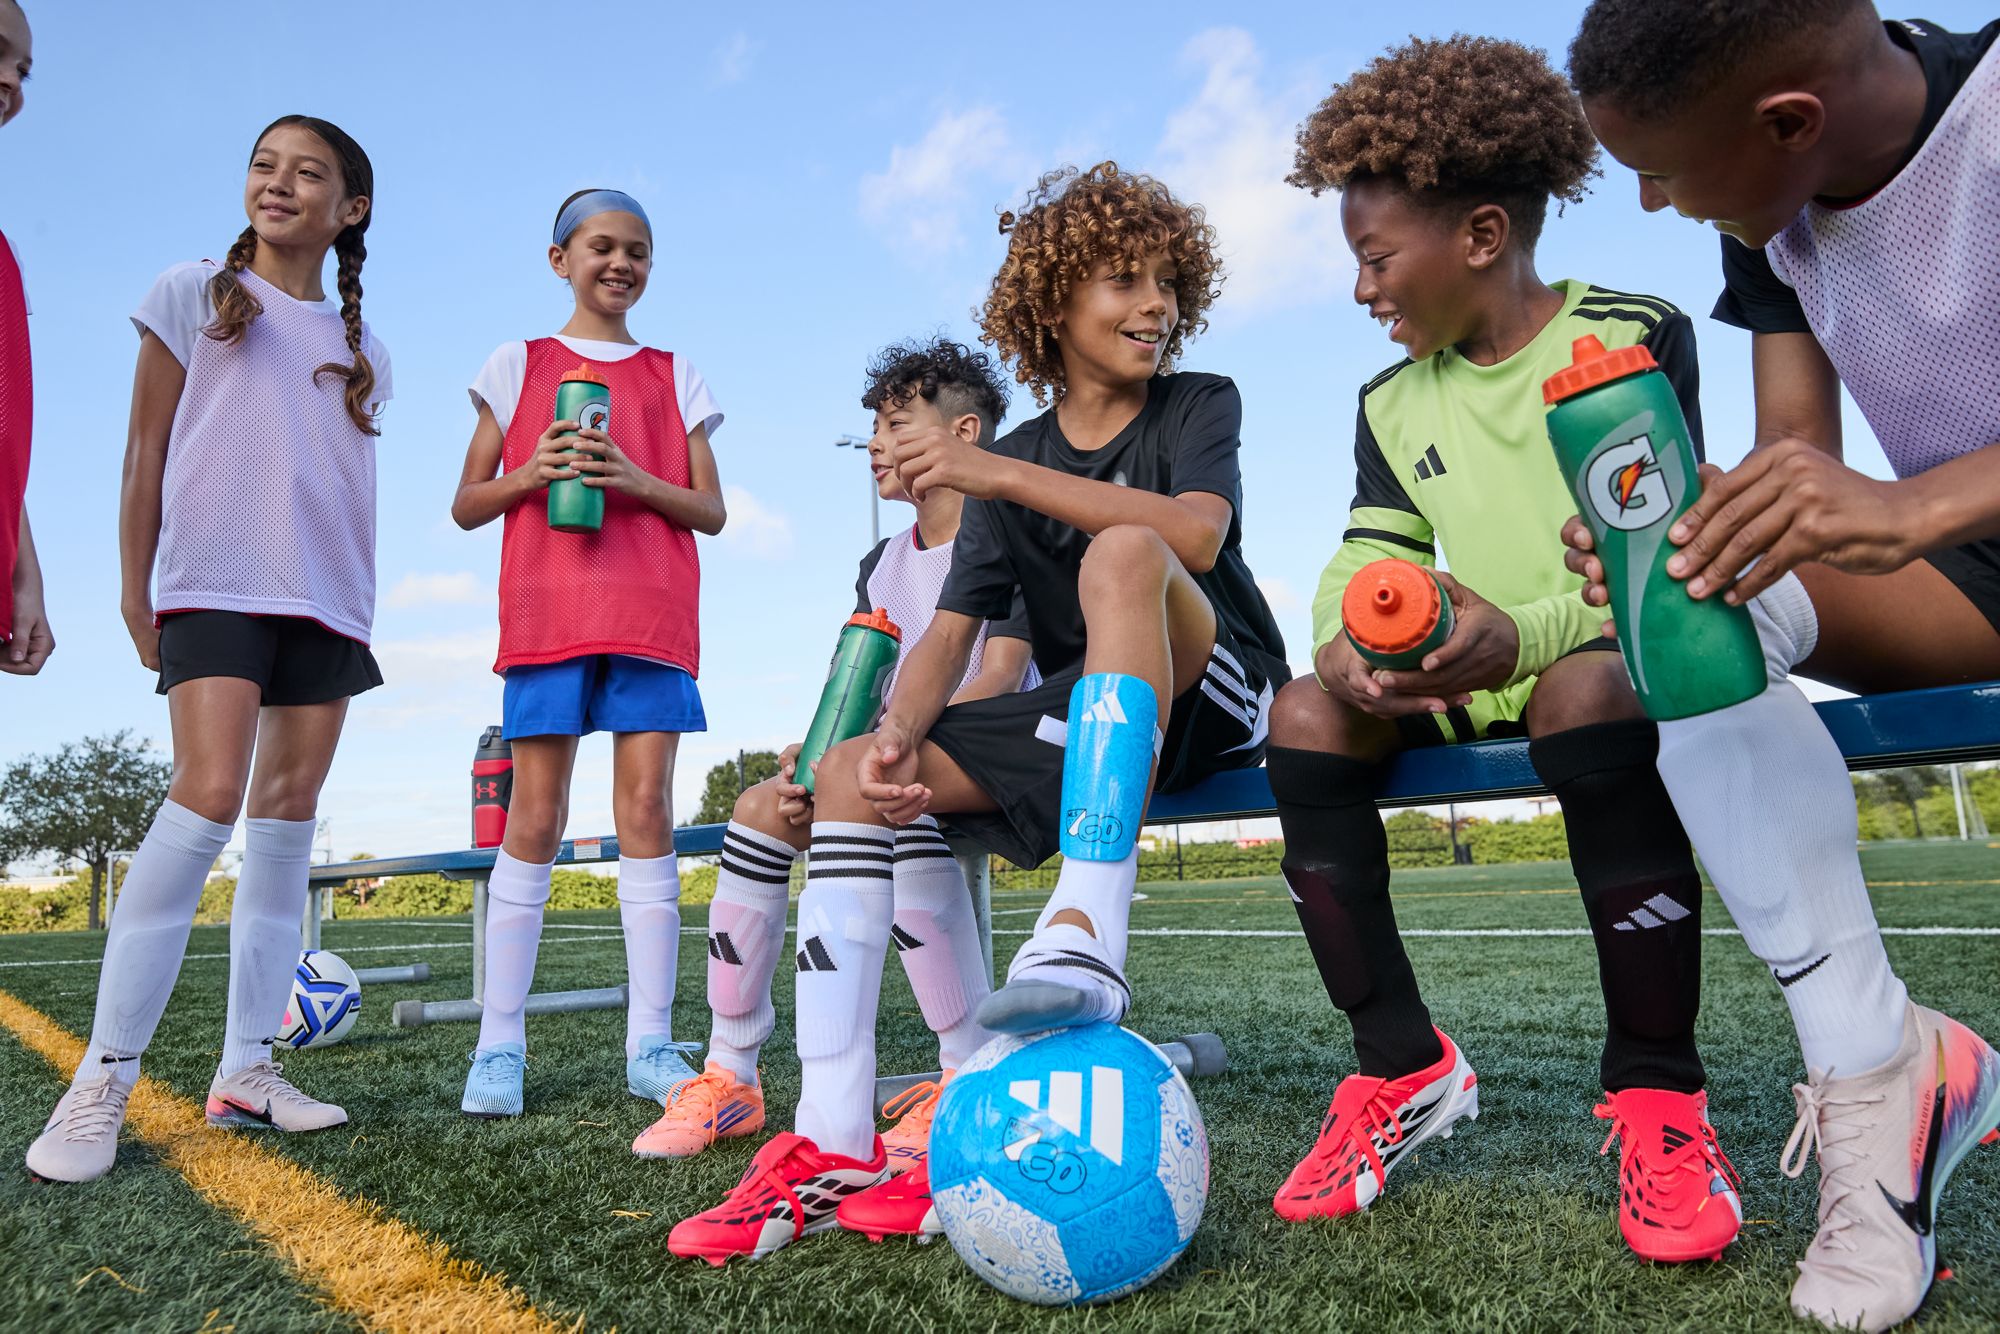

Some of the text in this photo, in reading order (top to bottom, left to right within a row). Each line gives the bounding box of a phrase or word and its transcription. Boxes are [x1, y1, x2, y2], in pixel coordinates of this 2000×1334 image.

[1586, 433, 1673, 531] G
[1078, 815, 1122, 844] GO
[1018, 1142, 1087, 1194] GO
